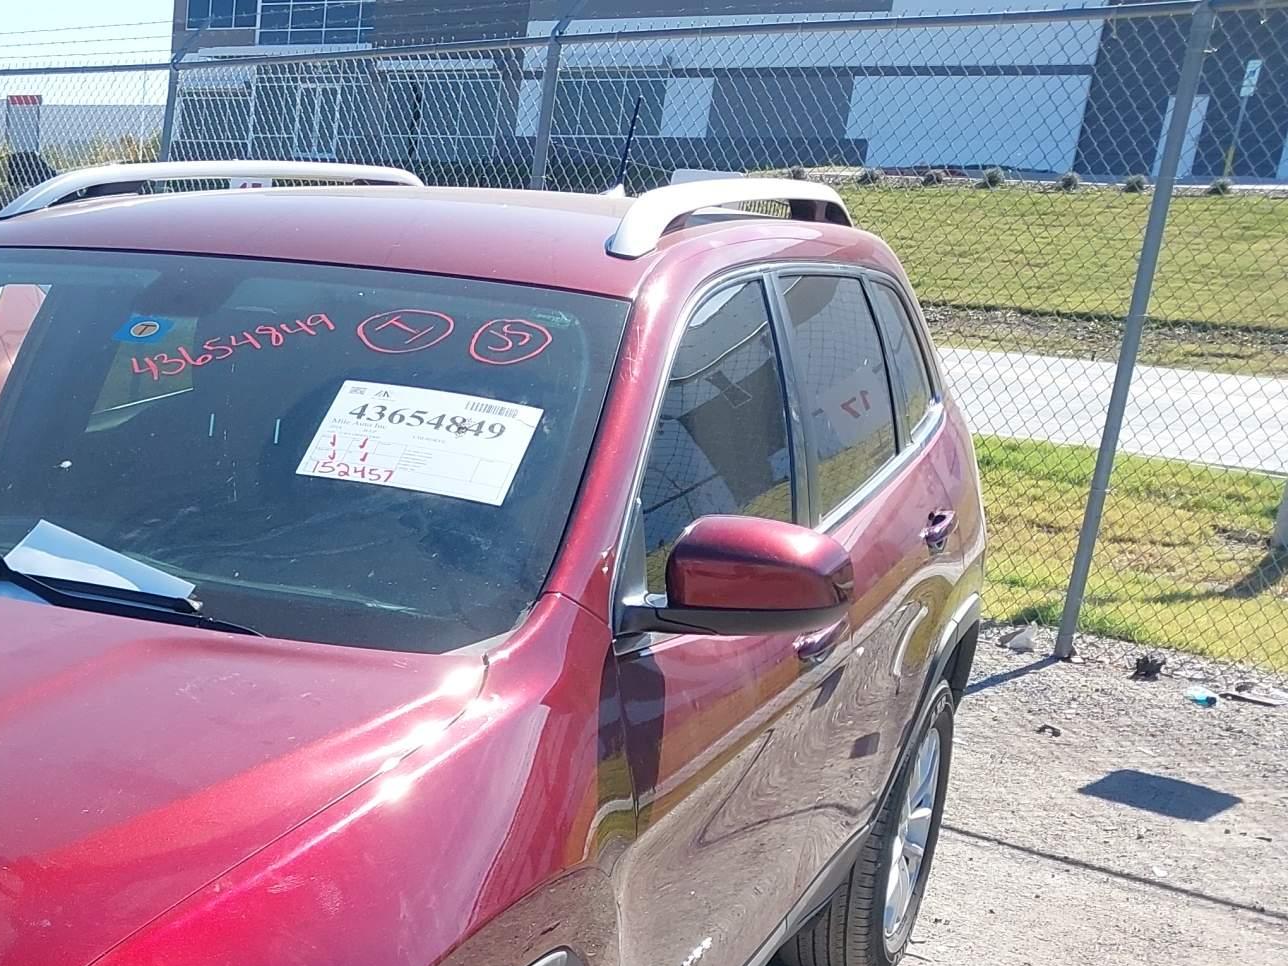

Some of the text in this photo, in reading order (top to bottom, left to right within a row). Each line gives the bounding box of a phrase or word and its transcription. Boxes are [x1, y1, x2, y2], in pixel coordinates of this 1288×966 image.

[130, 312, 336, 380] 43654849
[348, 402, 507, 440] 43654849
[311, 460, 395, 483] 152457
